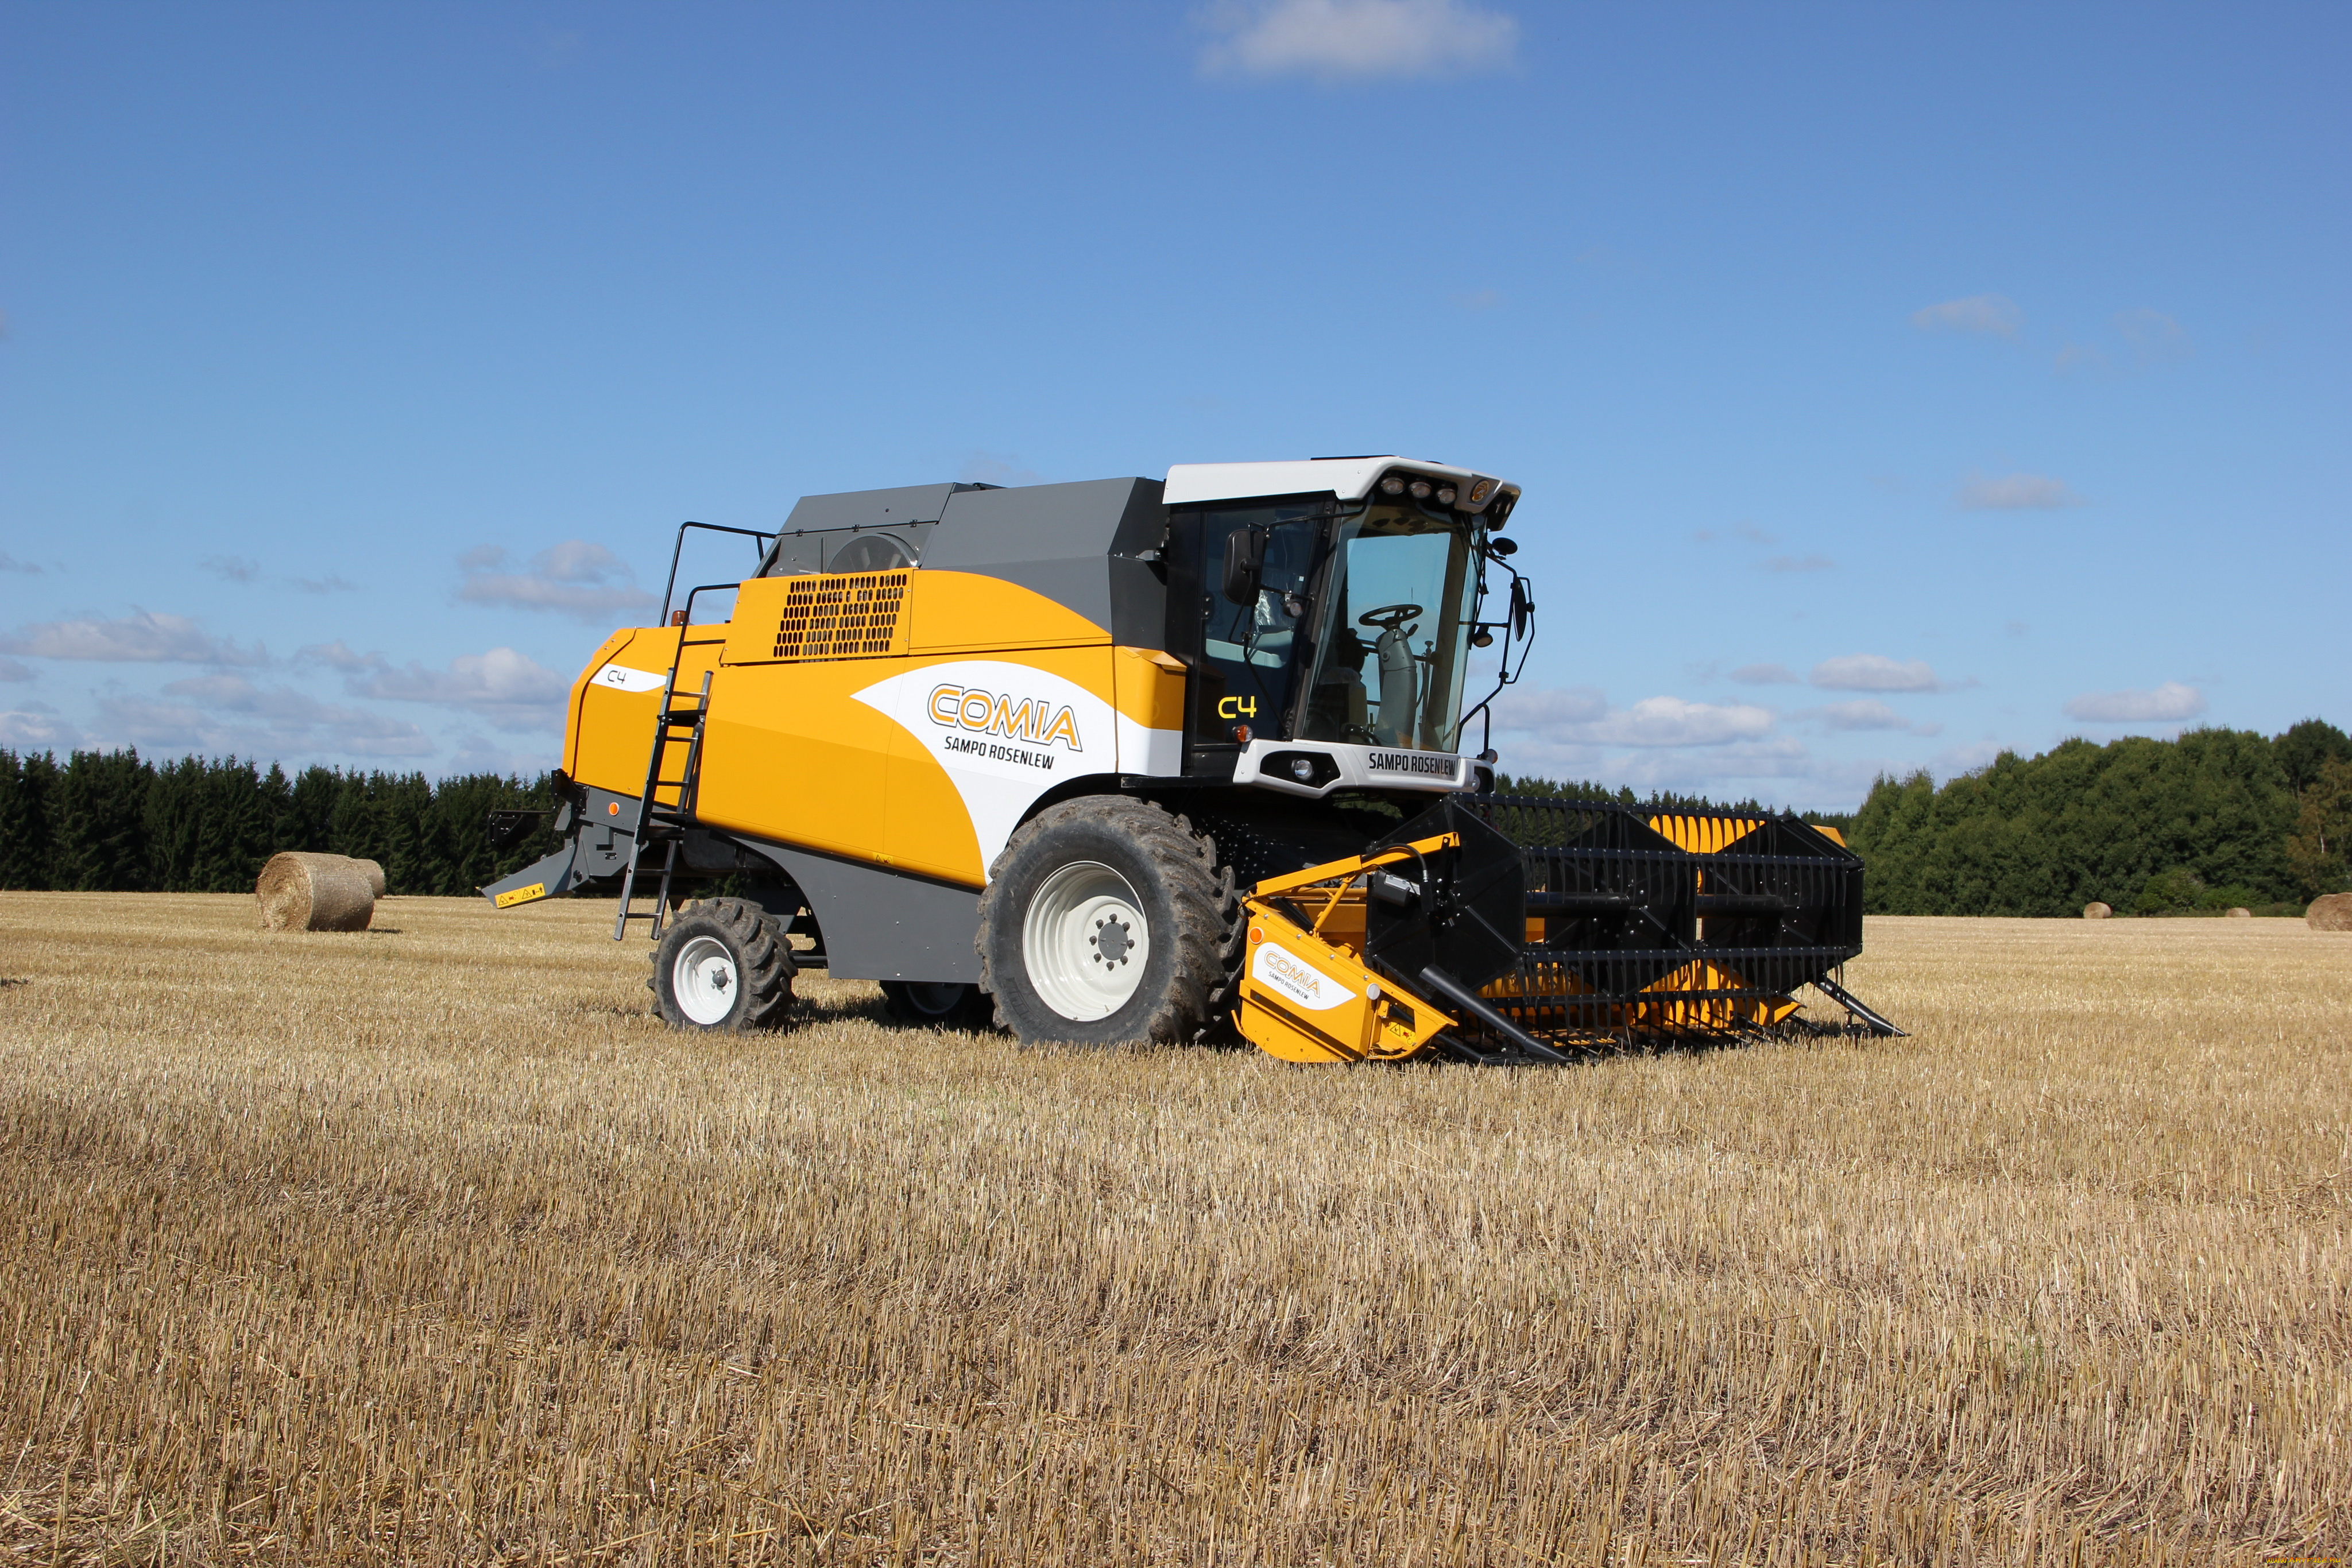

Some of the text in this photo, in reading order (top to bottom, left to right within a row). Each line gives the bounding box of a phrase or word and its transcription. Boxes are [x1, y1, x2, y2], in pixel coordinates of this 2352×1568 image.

[608, 670, 626, 684] C4
[927, 683, 1082, 752] COMIA
[1218, 696, 1256, 719] C4
[945, 736, 1054, 769] SAMPO ROSENLEW
[1369, 753, 1456, 776] SAMPO ROSENLEW
[1264, 951, 1320, 998] COMIA
[1268, 971, 1309, 1000] SAMPO ROSENLEW
